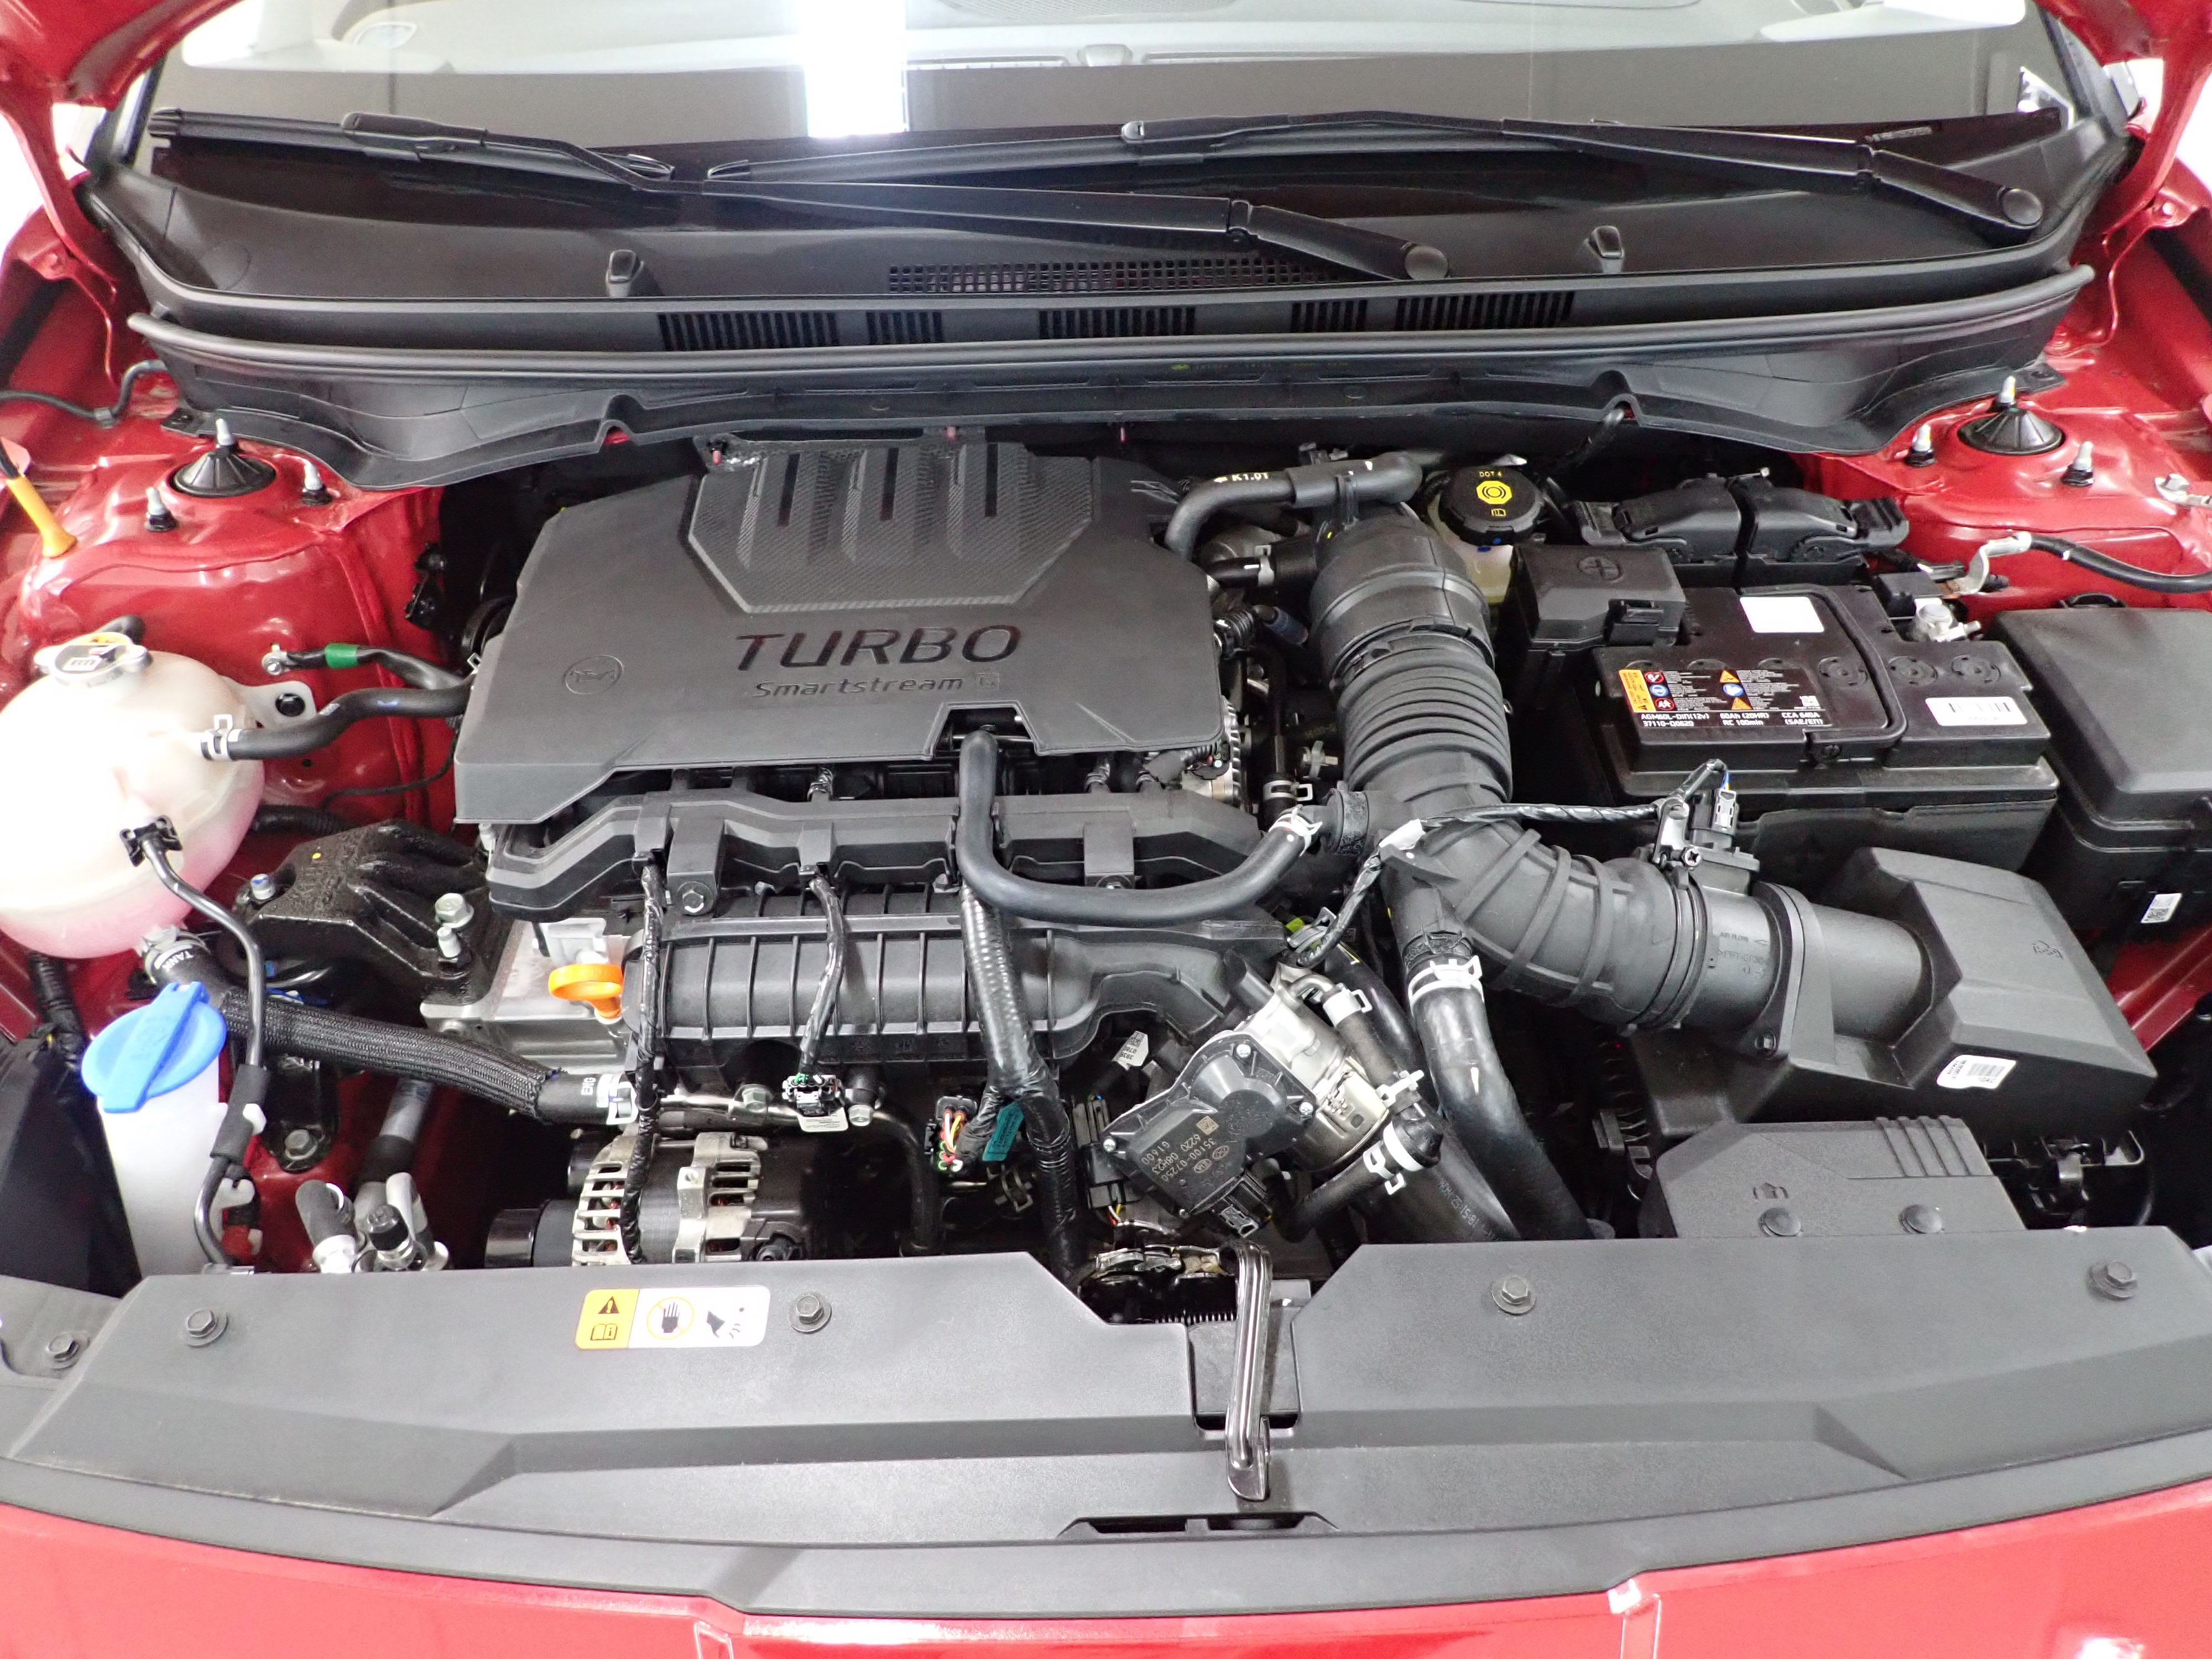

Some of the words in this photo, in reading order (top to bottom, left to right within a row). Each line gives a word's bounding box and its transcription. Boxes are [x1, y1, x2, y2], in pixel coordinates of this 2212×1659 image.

[736, 625, 1021, 671] TURBO
[753, 676, 964, 698] Smartstream
[161, 951, 195, 972] TANK
[581, 1077, 596, 1095] ENG
